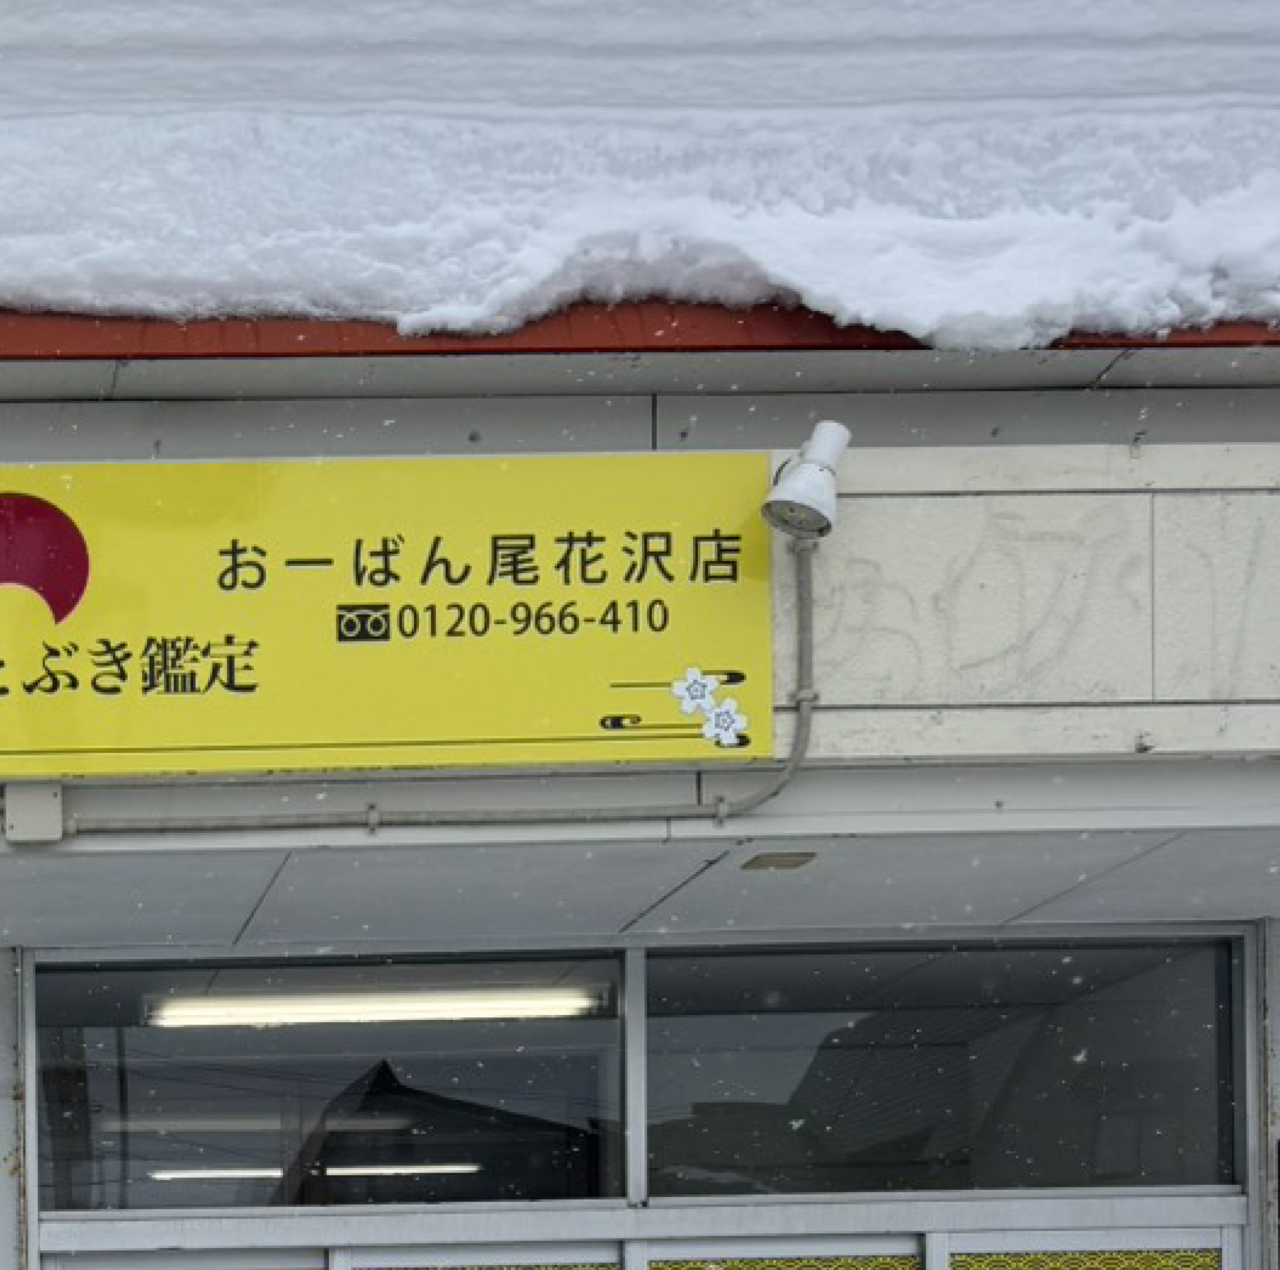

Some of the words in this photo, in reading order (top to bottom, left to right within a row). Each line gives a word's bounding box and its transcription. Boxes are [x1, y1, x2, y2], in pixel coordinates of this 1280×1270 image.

[214, 526, 746, 592] おーばん尾花沢店
[394, 597, 672, 640] 0120-966-410
